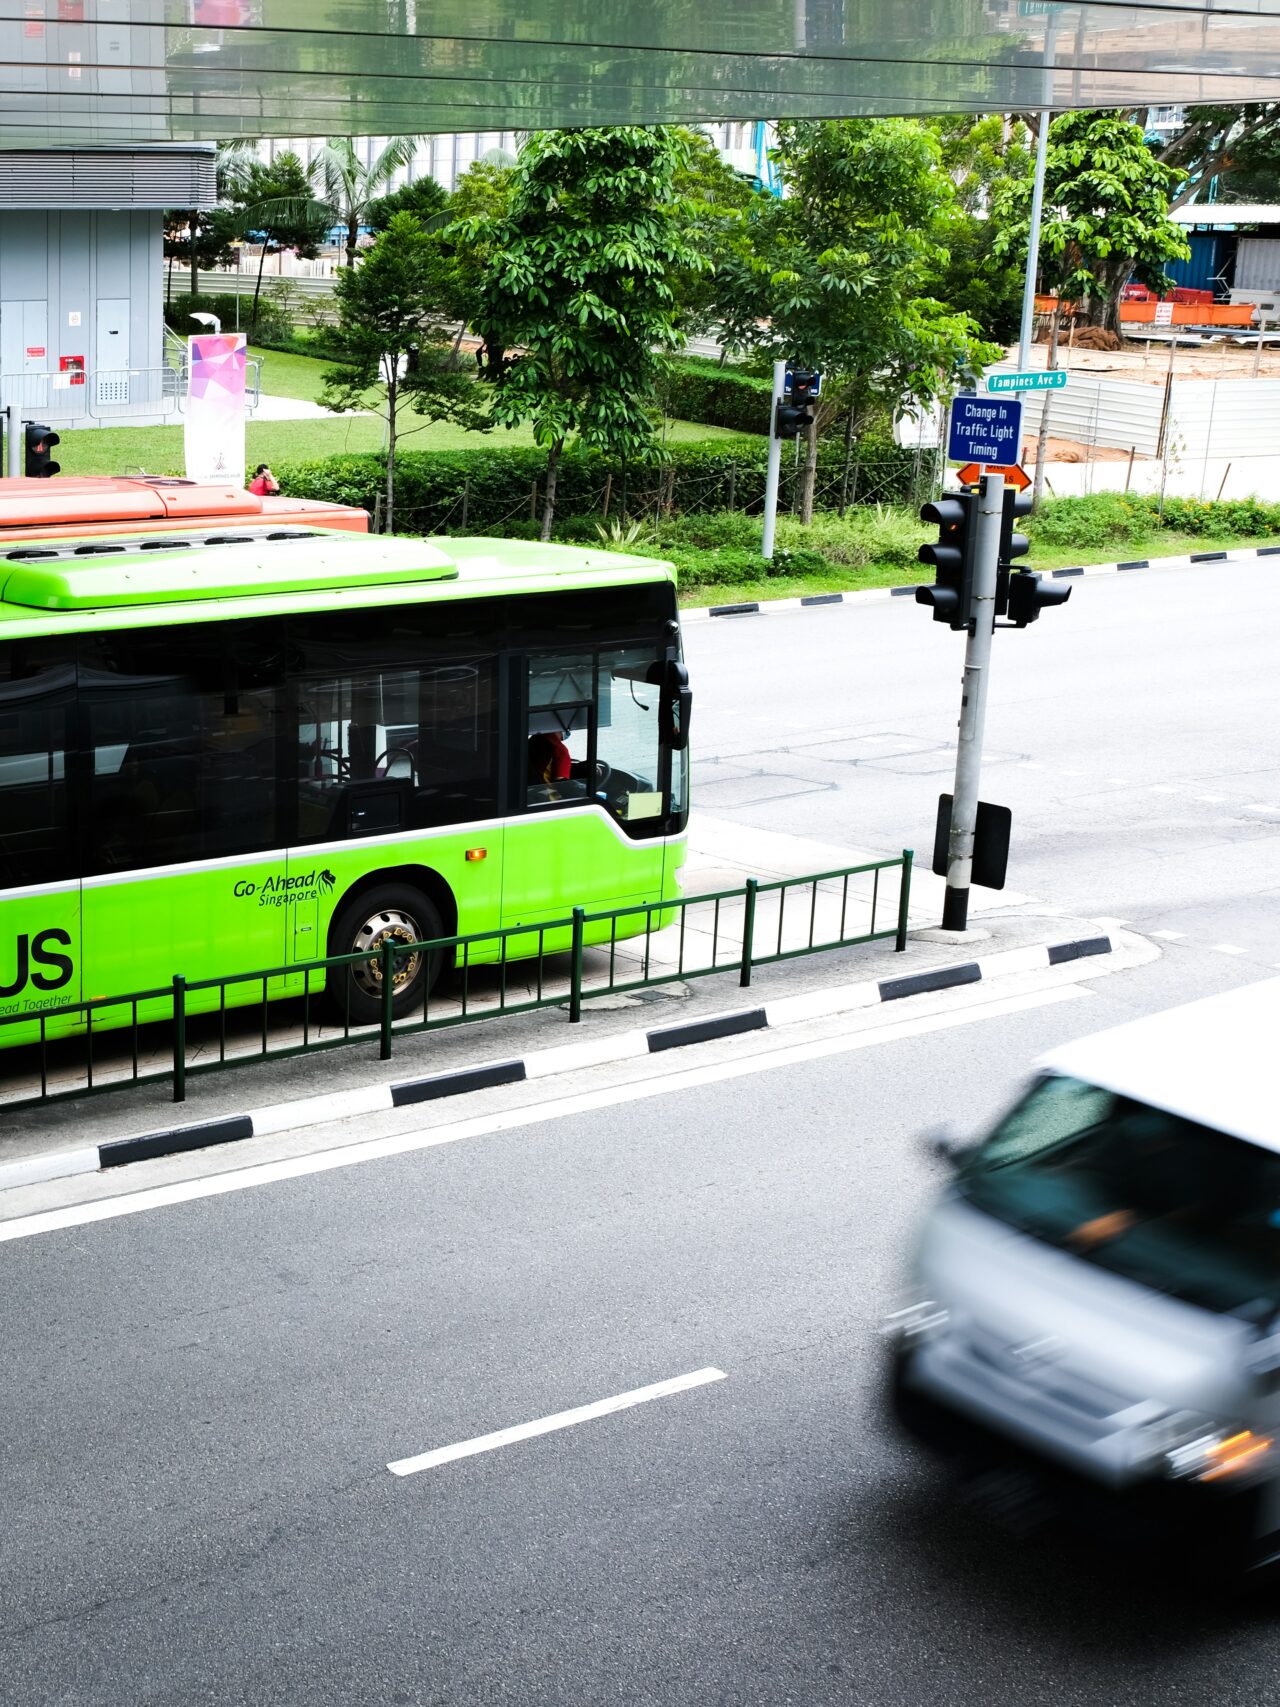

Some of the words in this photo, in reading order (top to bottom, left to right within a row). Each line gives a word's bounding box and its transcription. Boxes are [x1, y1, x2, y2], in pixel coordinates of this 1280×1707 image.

[992, 376, 1034, 389] Tampines
[1037, 375, 1053, 385] Ave
[1057, 374, 1062, 384] 5
[965, 404, 997, 422] Change
[999, 406, 1007, 419] In
[956, 422, 987, 437] Traffic
[990, 425, 1014, 442] Light
[969, 441, 998, 460] Timing
[233, 870, 316, 897] Go-Ahead
[259, 889, 317, 907] Singapore
[23, 994, 72, 1013] Together
